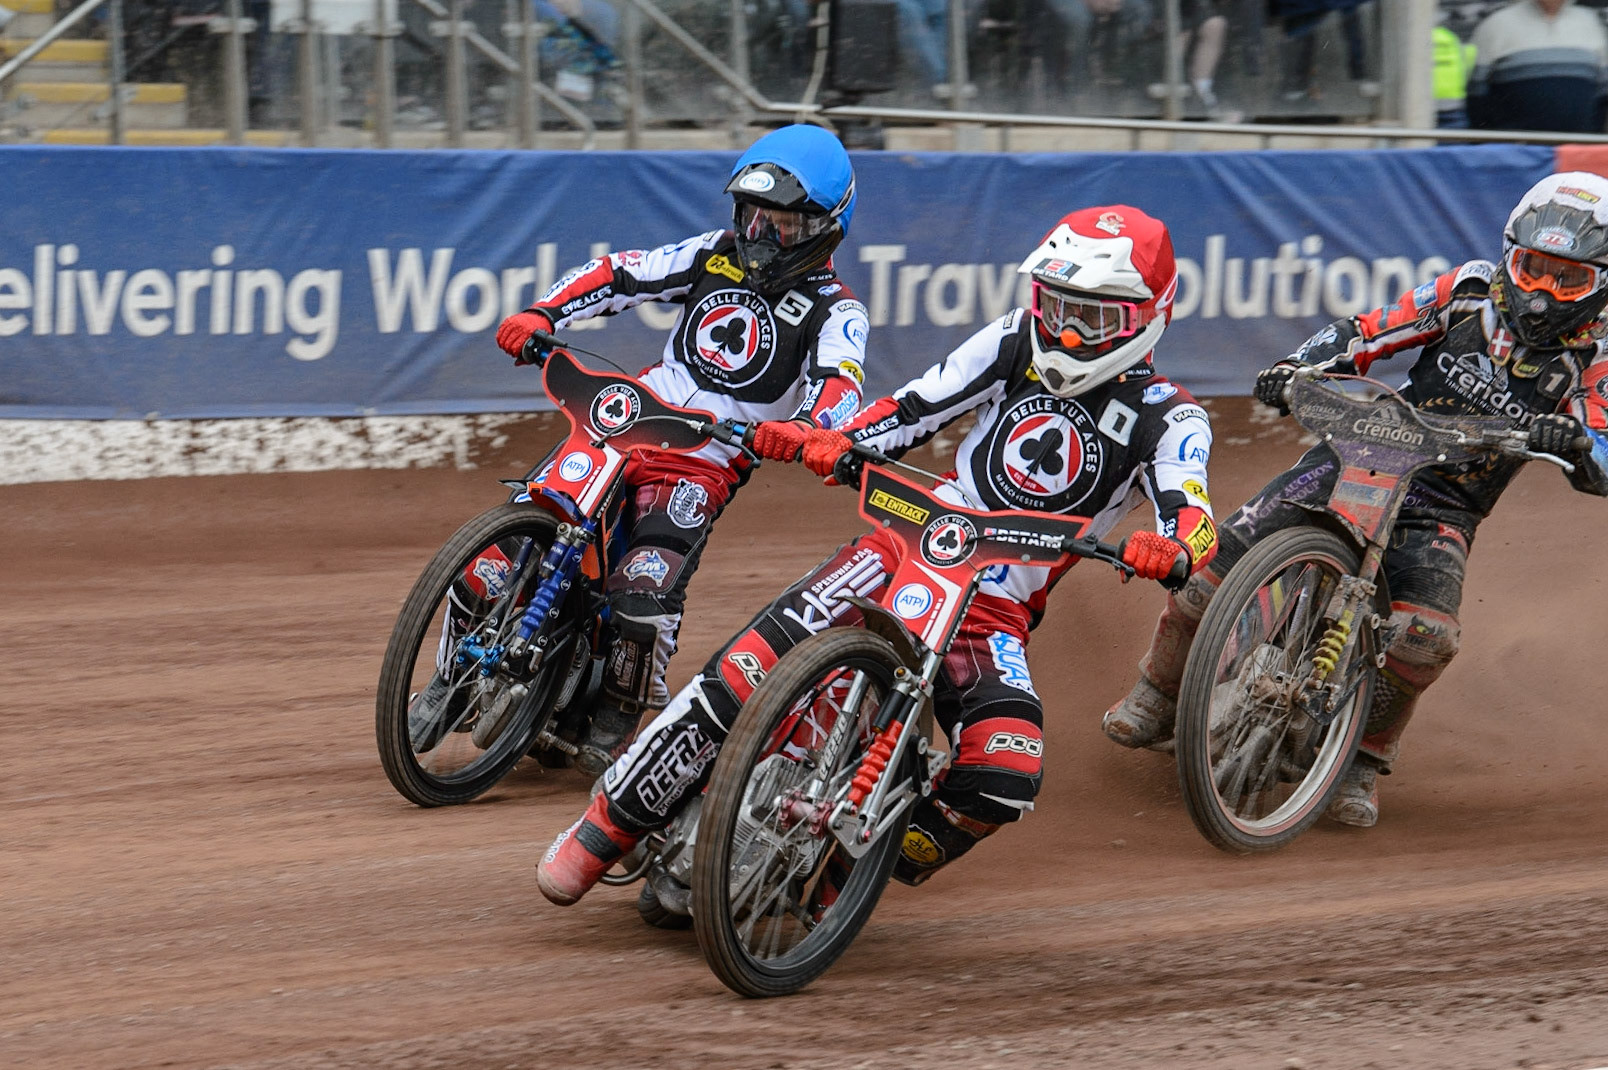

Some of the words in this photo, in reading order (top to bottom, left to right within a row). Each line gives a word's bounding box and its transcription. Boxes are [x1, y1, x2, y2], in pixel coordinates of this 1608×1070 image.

[367, 242, 610, 334] Worl
[859, 244, 1033, 328] Trav
[701, 293, 740, 313] BELLE
[759, 318, 771, 350] ACES
[599, 386, 617, 399] BELLE
[1437, 352, 1536, 427] Crendon
[1544, 372, 1566, 392] 1
[1011, 399, 1052, 422] BELLE
[1060, 402, 1087, 426] VUE
[1082, 432, 1098, 473] ACES
[1352, 418, 1424, 446] Crendon
[565, 460, 585, 474] ATPI
[1284, 460, 1335, 497] AUCTION
[886, 497, 924, 524] ENTRACK
[928, 517, 949, 532] BELLE
[951, 517, 965, 526] VUE
[811, 560, 853, 594] SPEEDWAY
[900, 594, 924, 609] ATPI
